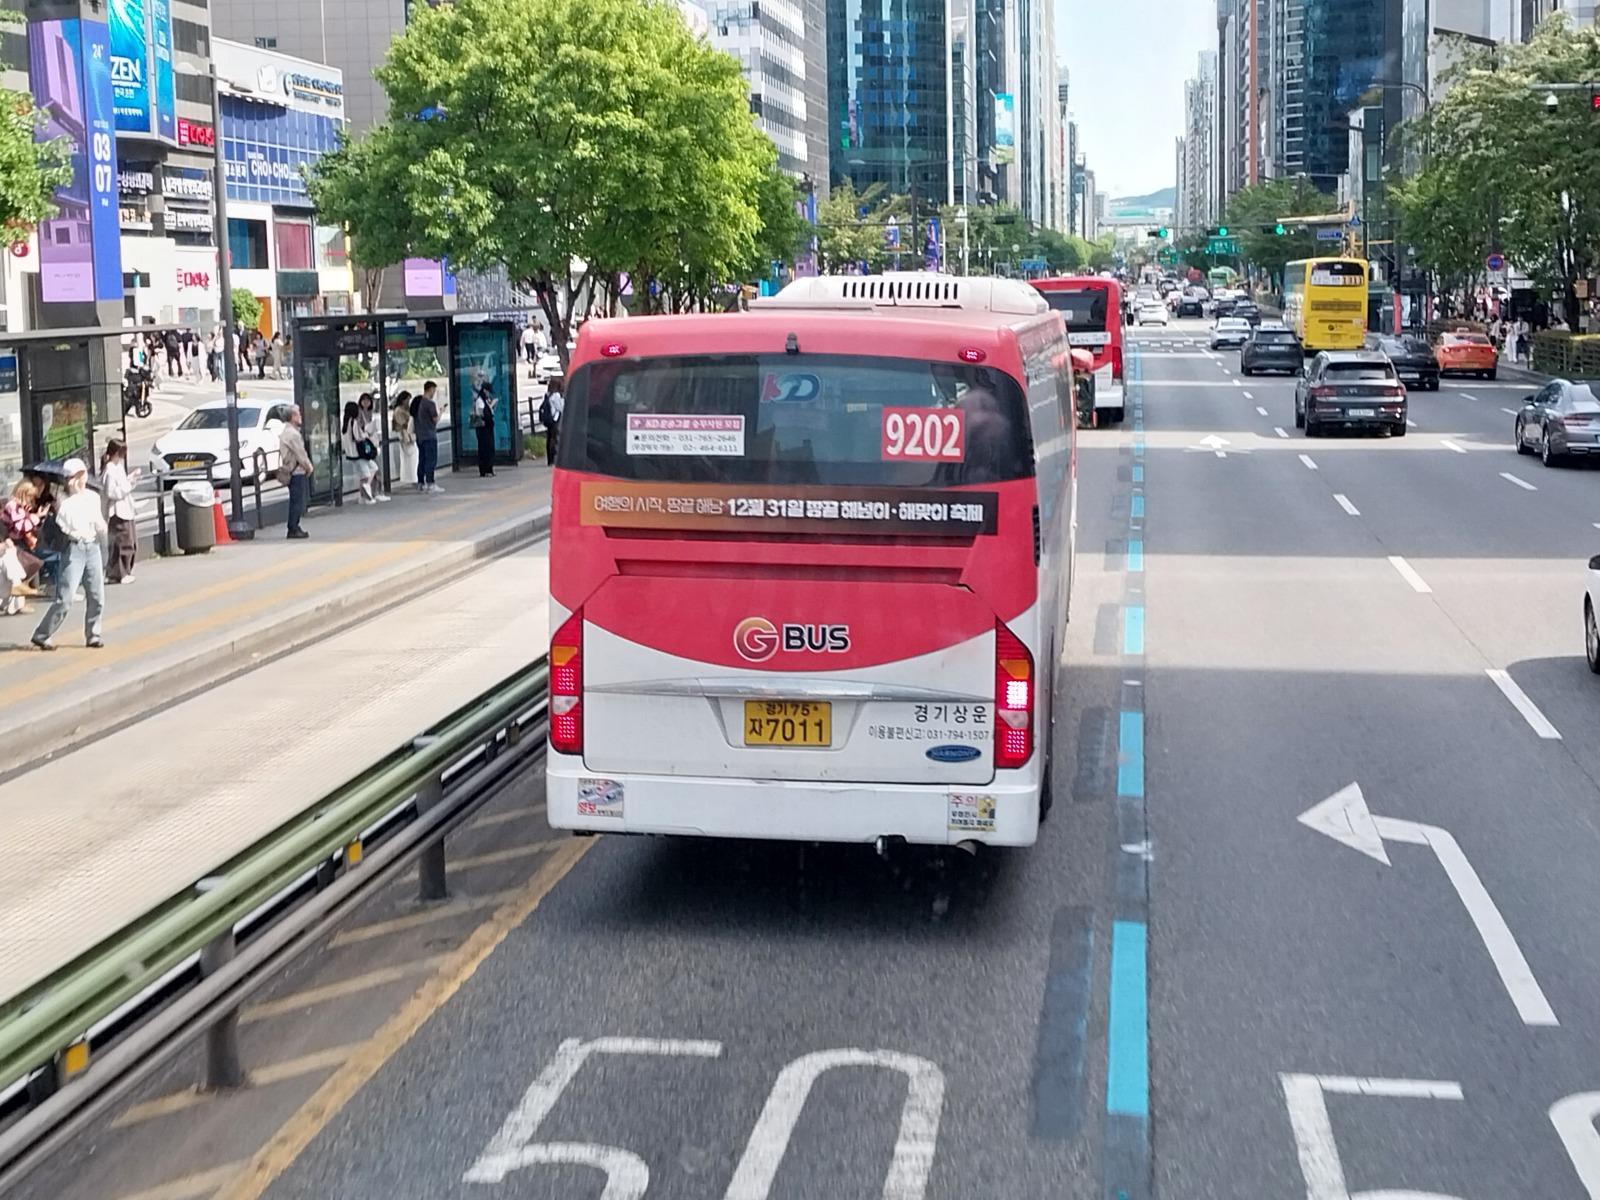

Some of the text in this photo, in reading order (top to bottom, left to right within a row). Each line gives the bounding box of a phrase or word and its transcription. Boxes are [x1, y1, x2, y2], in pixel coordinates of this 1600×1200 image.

[93, 132, 111, 161] 03
[95, 164, 112, 192] 07
[886, 412, 961, 457] 9202
[593, 495, 633, 513] 여행의
[727, 498, 764, 517] 12월
[765, 499, 804, 518] 31일
[783, 624, 851, 652] BUS
[914, 704, 987, 724] 경기상운
